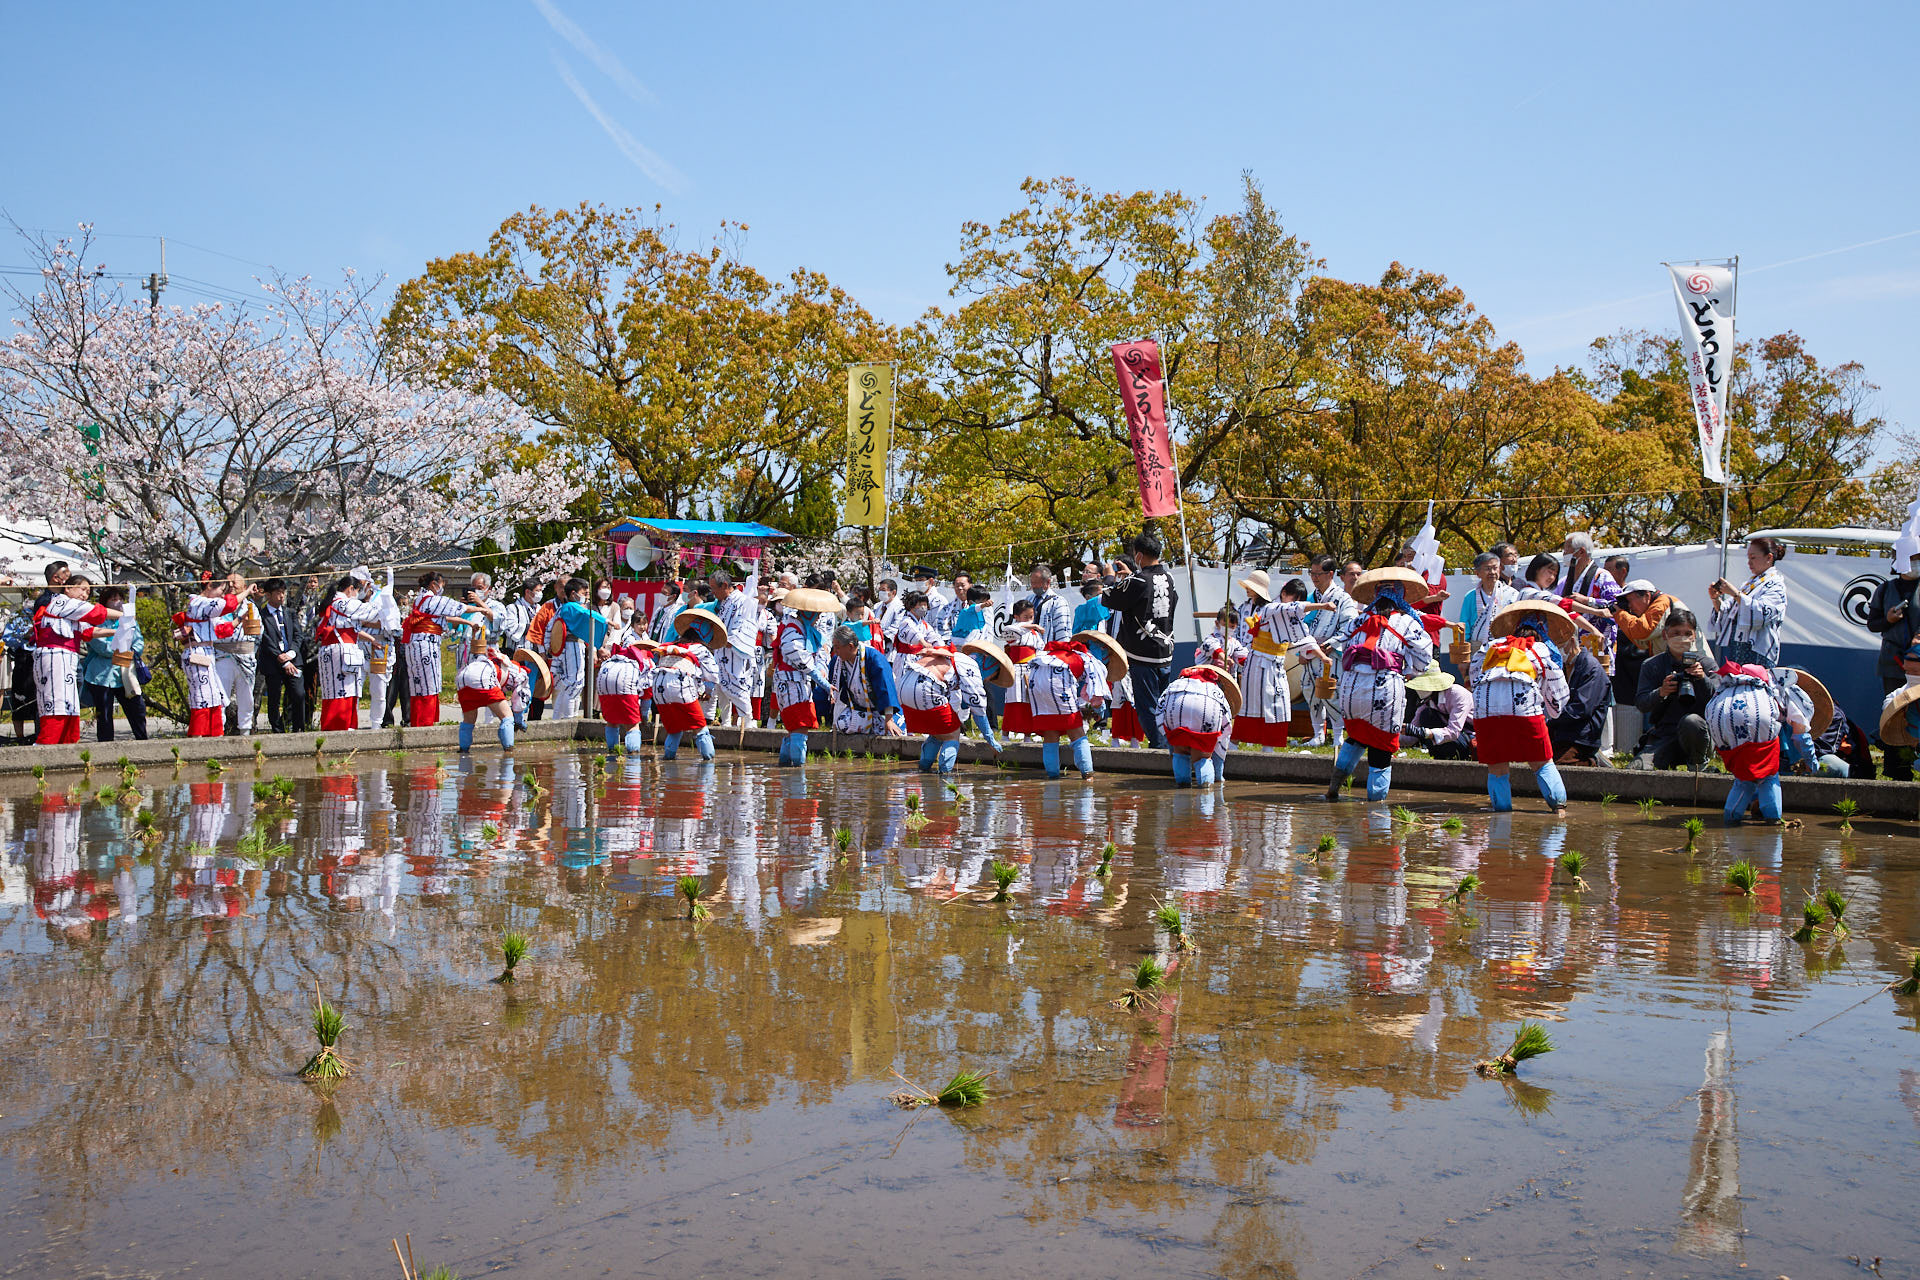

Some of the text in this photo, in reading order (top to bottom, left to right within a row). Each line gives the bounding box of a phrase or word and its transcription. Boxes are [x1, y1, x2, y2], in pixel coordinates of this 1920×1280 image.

[1689, 298, 1722, 393] どろん
[857, 390, 881, 516] どろんこ祭り
[1128, 366, 1166, 502] どろんこ祭り
